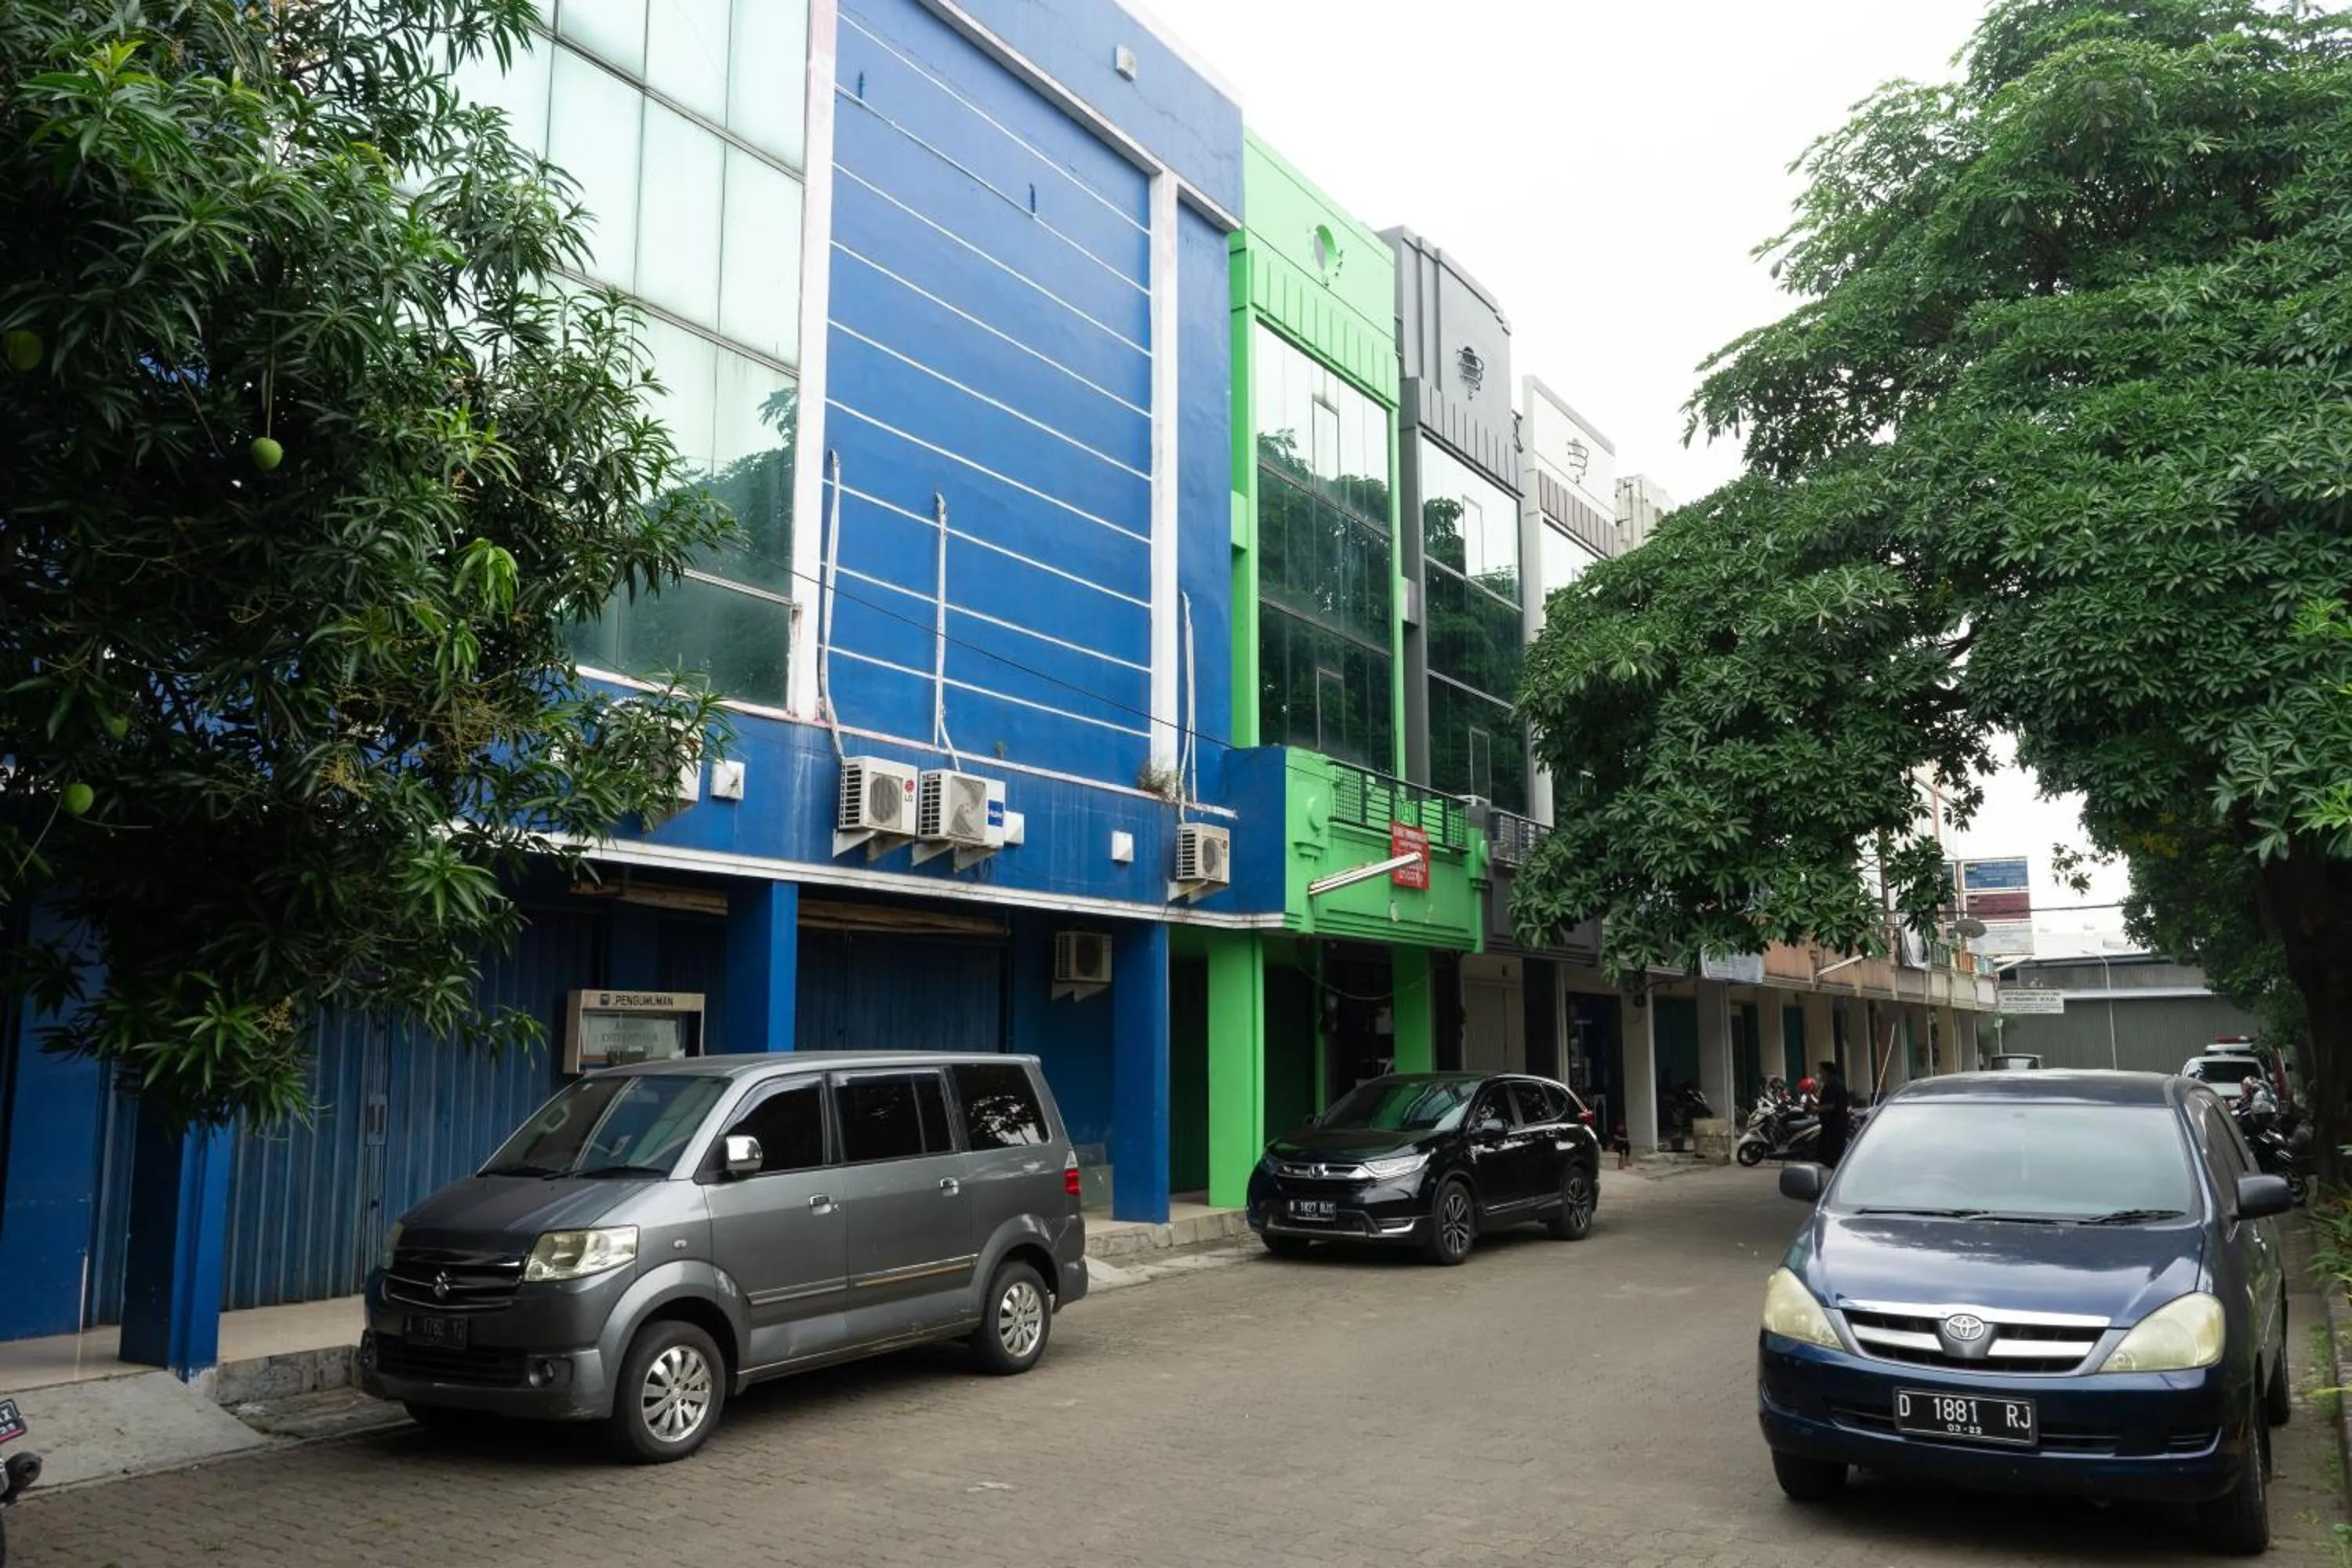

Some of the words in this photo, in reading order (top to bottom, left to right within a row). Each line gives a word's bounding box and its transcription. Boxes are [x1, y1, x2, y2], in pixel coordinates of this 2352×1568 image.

[615, 994, 673, 1007] PENGUMUMAN
[1898, 1395, 1911, 1417] D
[1933, 1397, 1978, 1424] 1881
[2006, 1404, 2032, 1429] RJ
